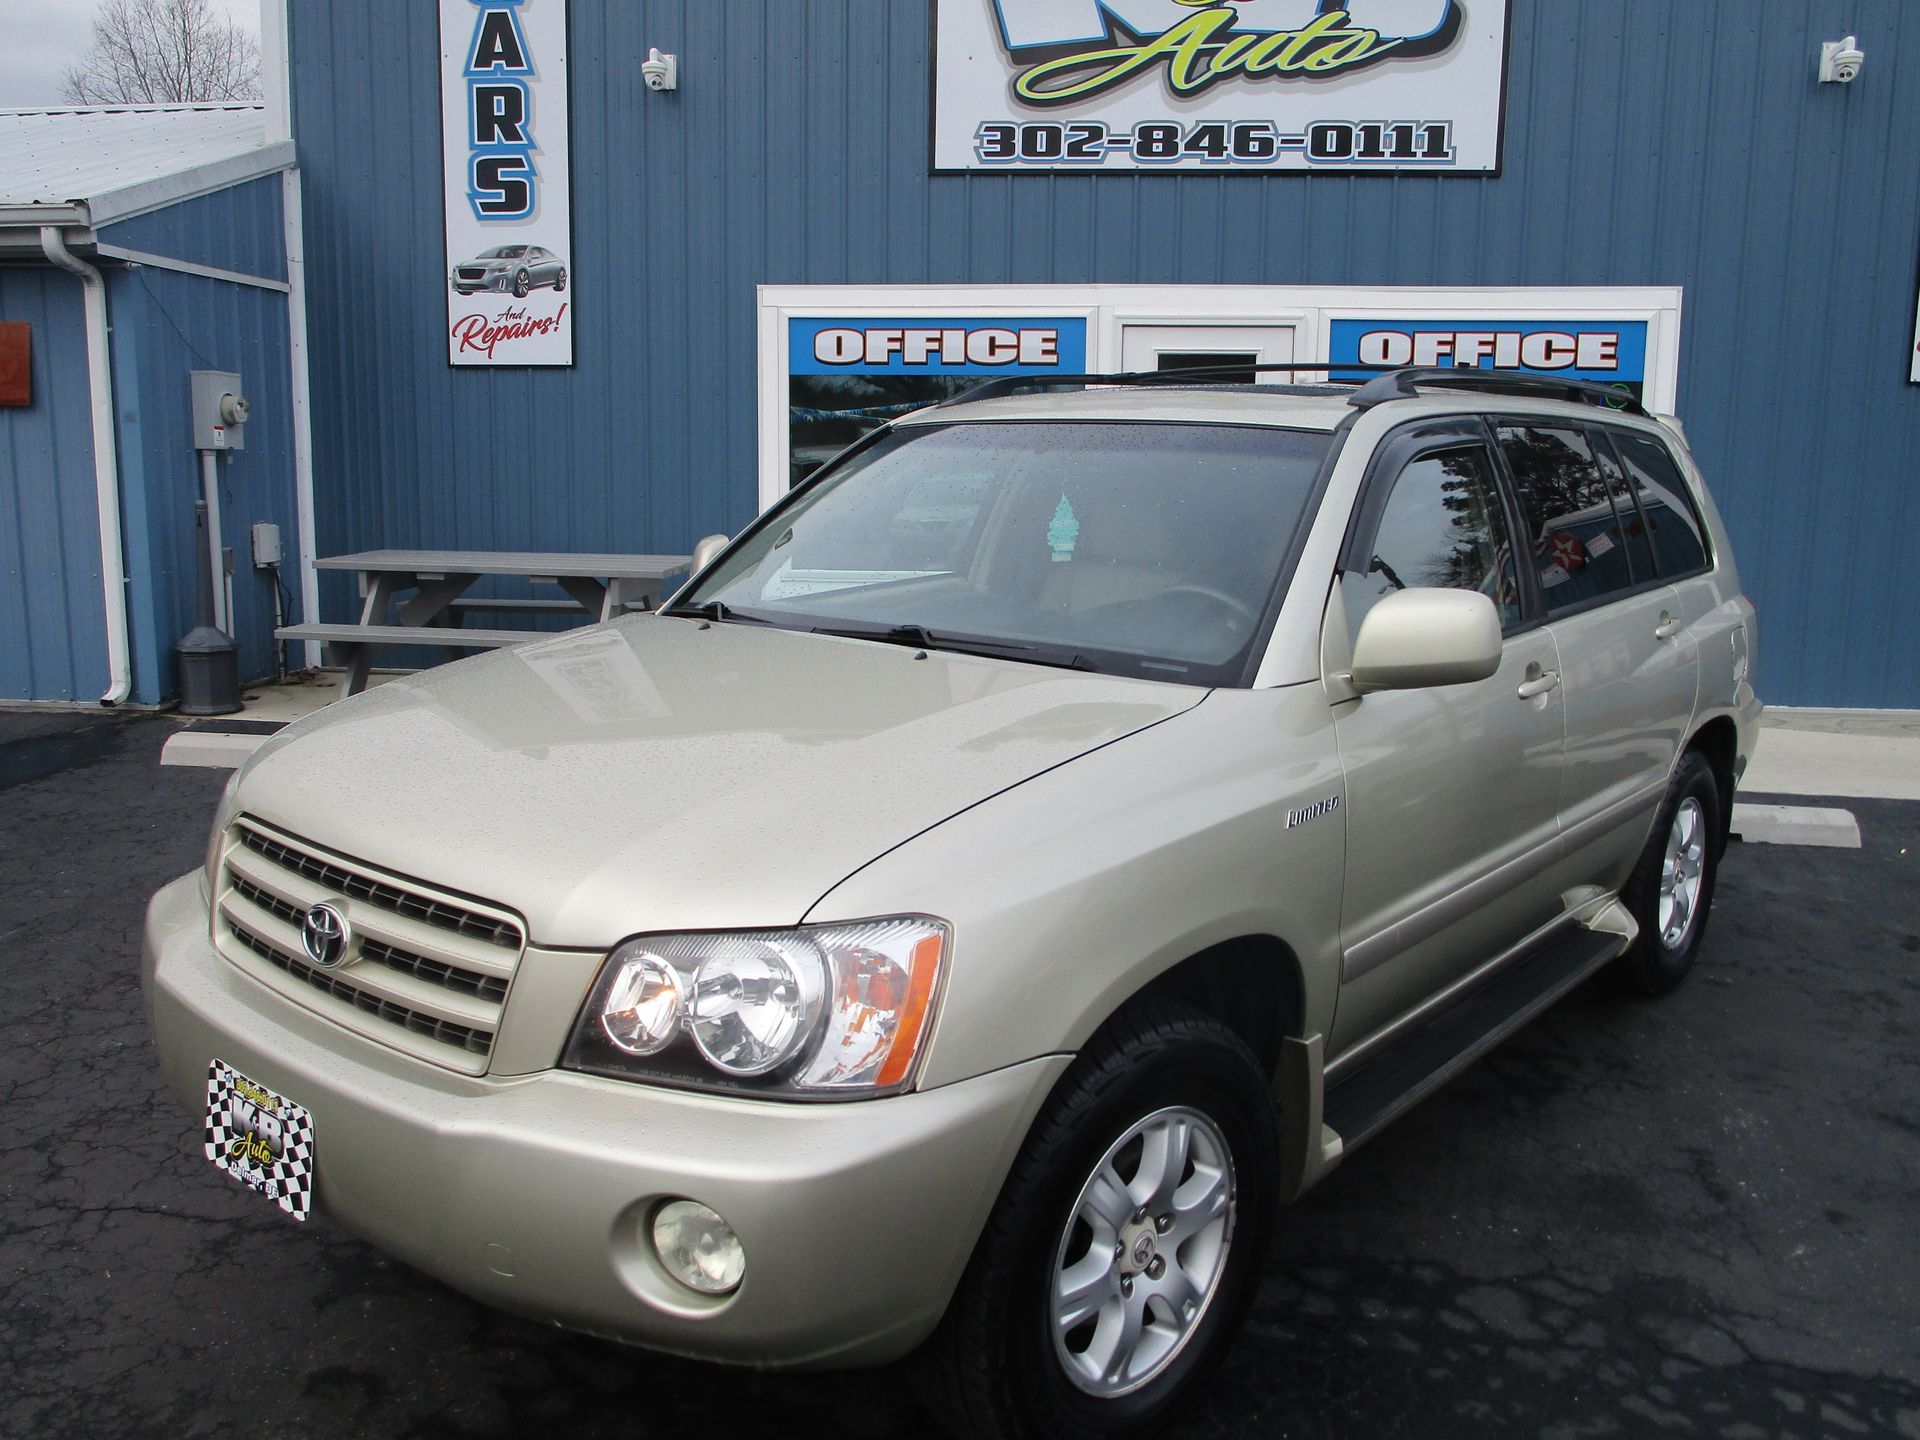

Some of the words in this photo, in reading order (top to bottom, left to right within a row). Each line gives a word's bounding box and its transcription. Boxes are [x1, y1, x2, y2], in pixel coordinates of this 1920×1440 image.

[1010, 8, 1406, 102] Auto
[463, 0, 536, 220] ARS
[976, 121, 1455, 163] 302-846-0111
[451, 302, 568, 360] Repairs!
[493, 305, 527, 324] And
[814, 328, 1059, 366] OFFICE
[1358, 330, 1619, 370] OFFICE
[1285, 796, 1339, 830] LIMITED
[230, 1131, 274, 1165] Auto
